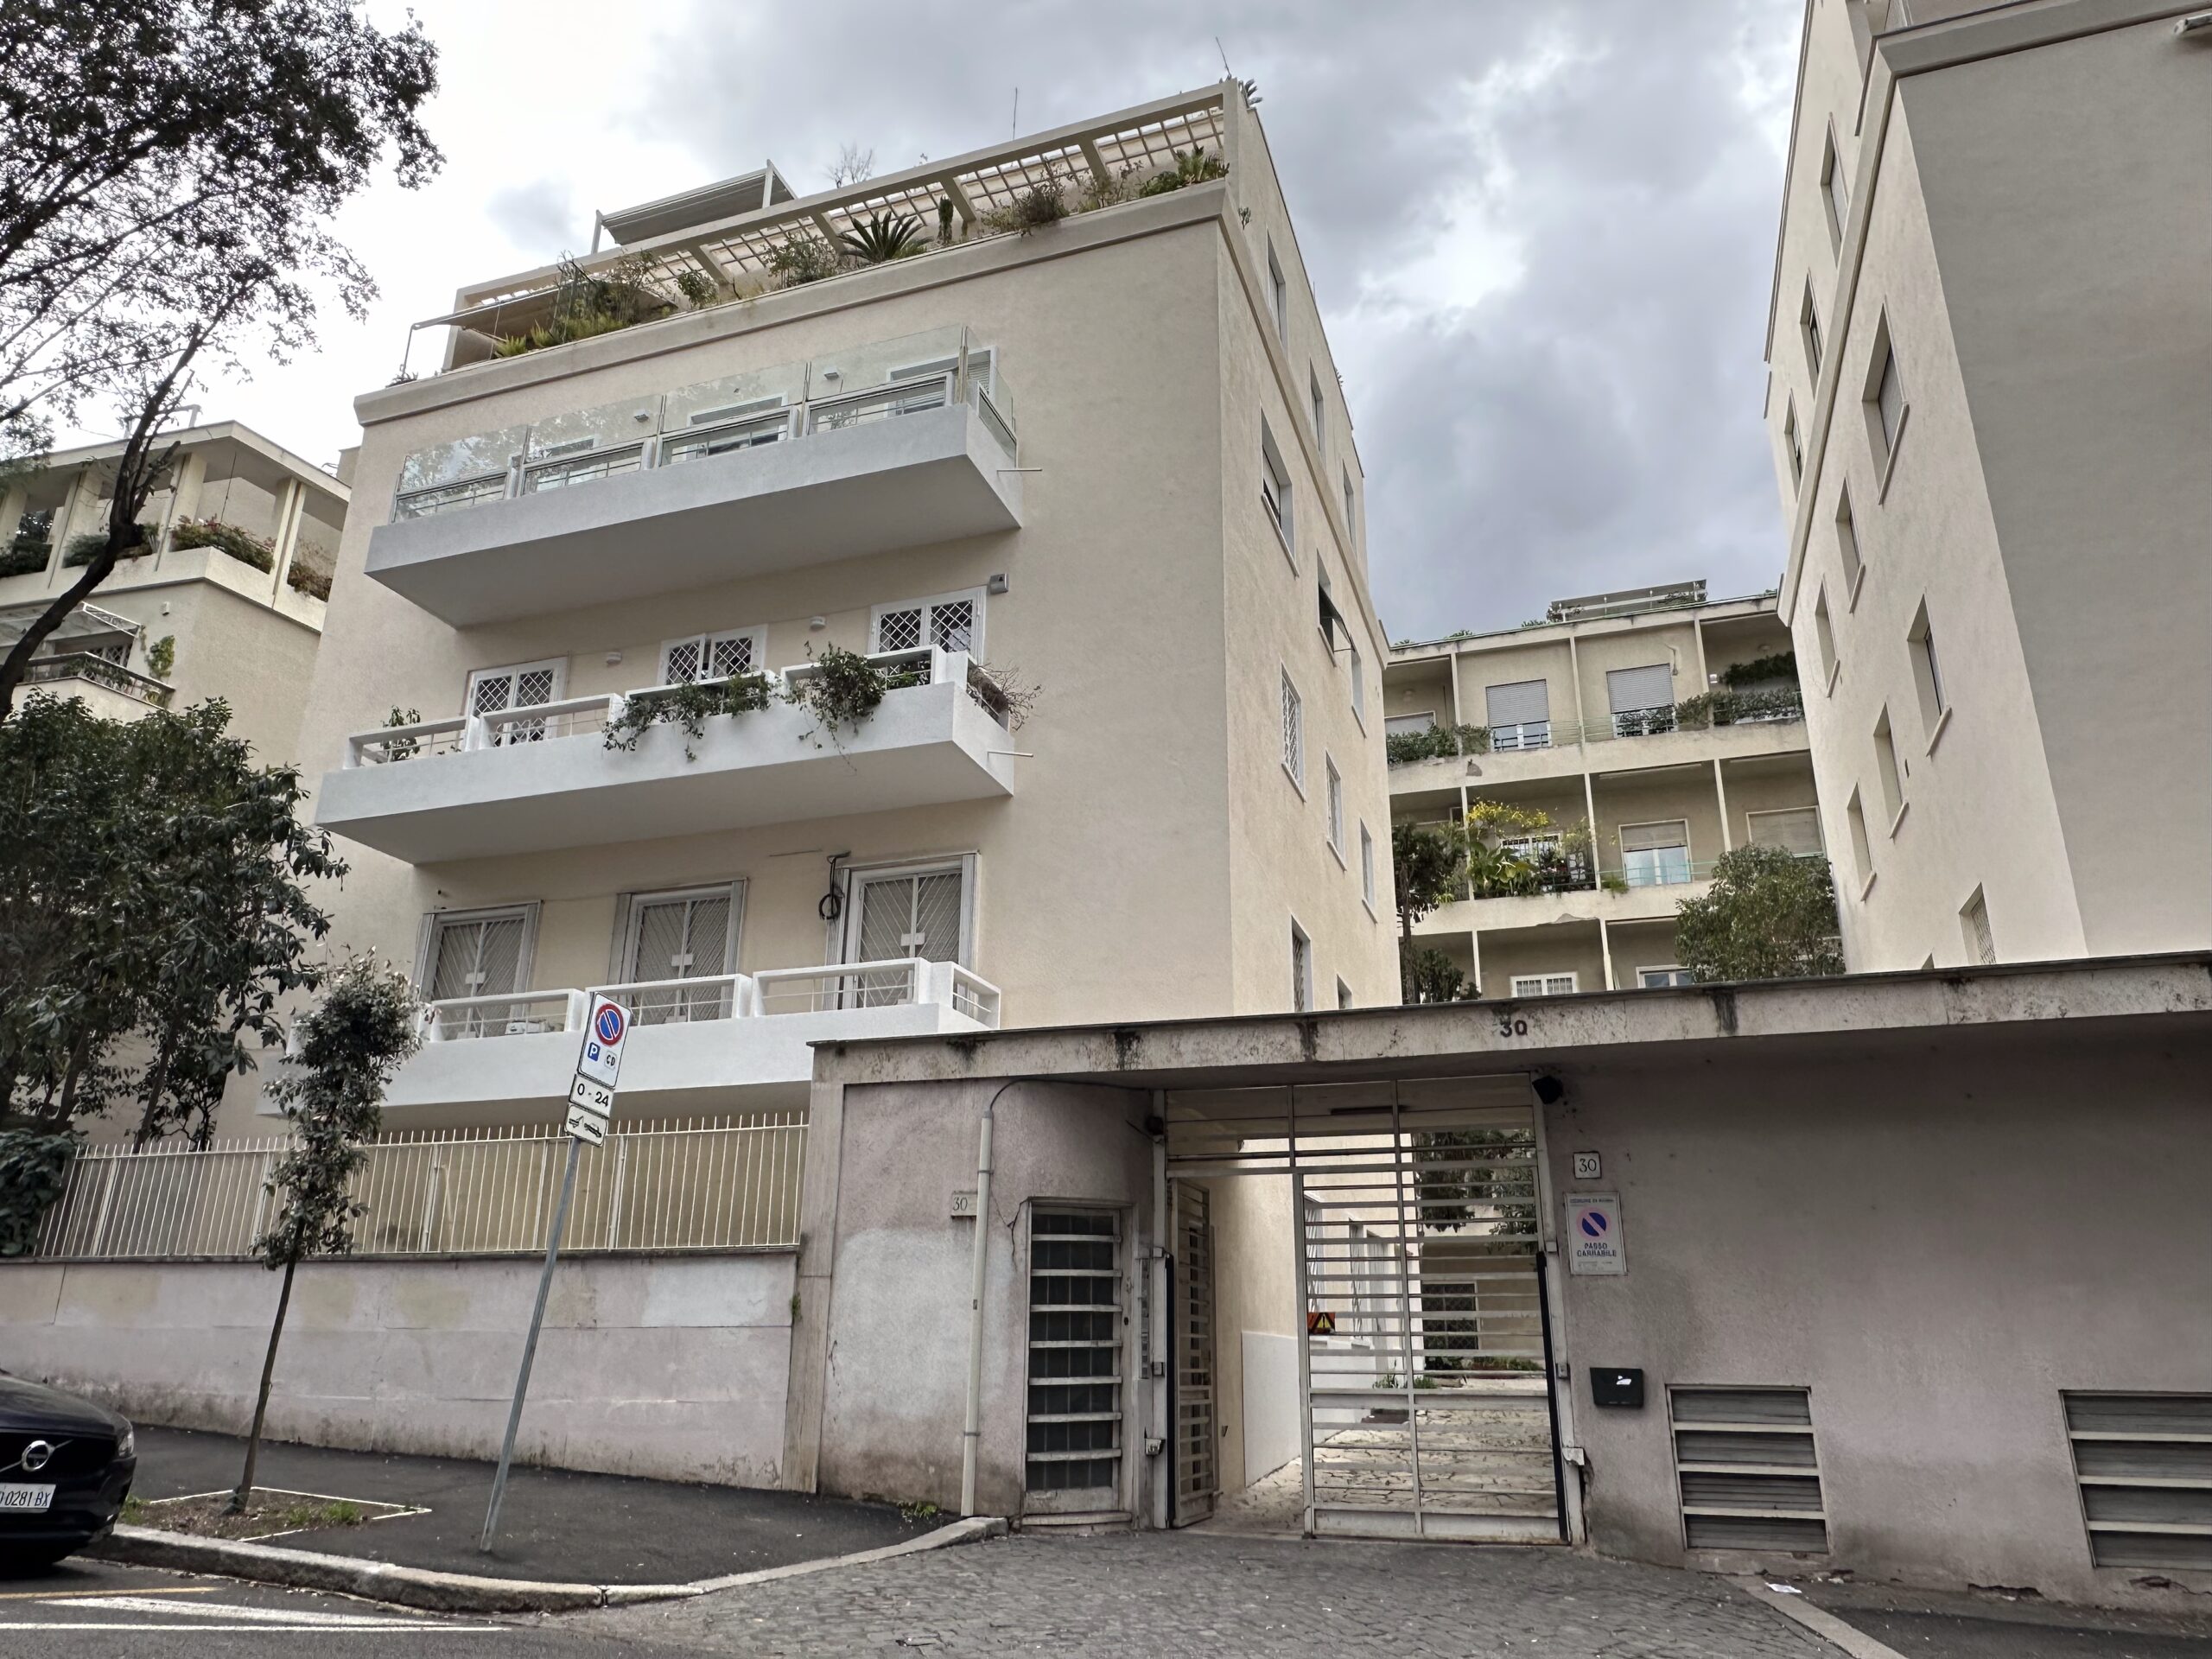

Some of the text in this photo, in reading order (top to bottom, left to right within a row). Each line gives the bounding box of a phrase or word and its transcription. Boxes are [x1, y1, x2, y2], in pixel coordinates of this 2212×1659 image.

[1500, 1018, 1528, 1038] 30
[589, 1044, 616, 1066] P CD
[577, 1083, 585, 1096] 0
[594, 1091, 609, 1107] 24
[1579, 1158, 1597, 1173] 30
[953, 1197, 968, 1211] 30
[4, 1491, 33, 1506] 0281
[35, 1491, 51, 1506] BX
